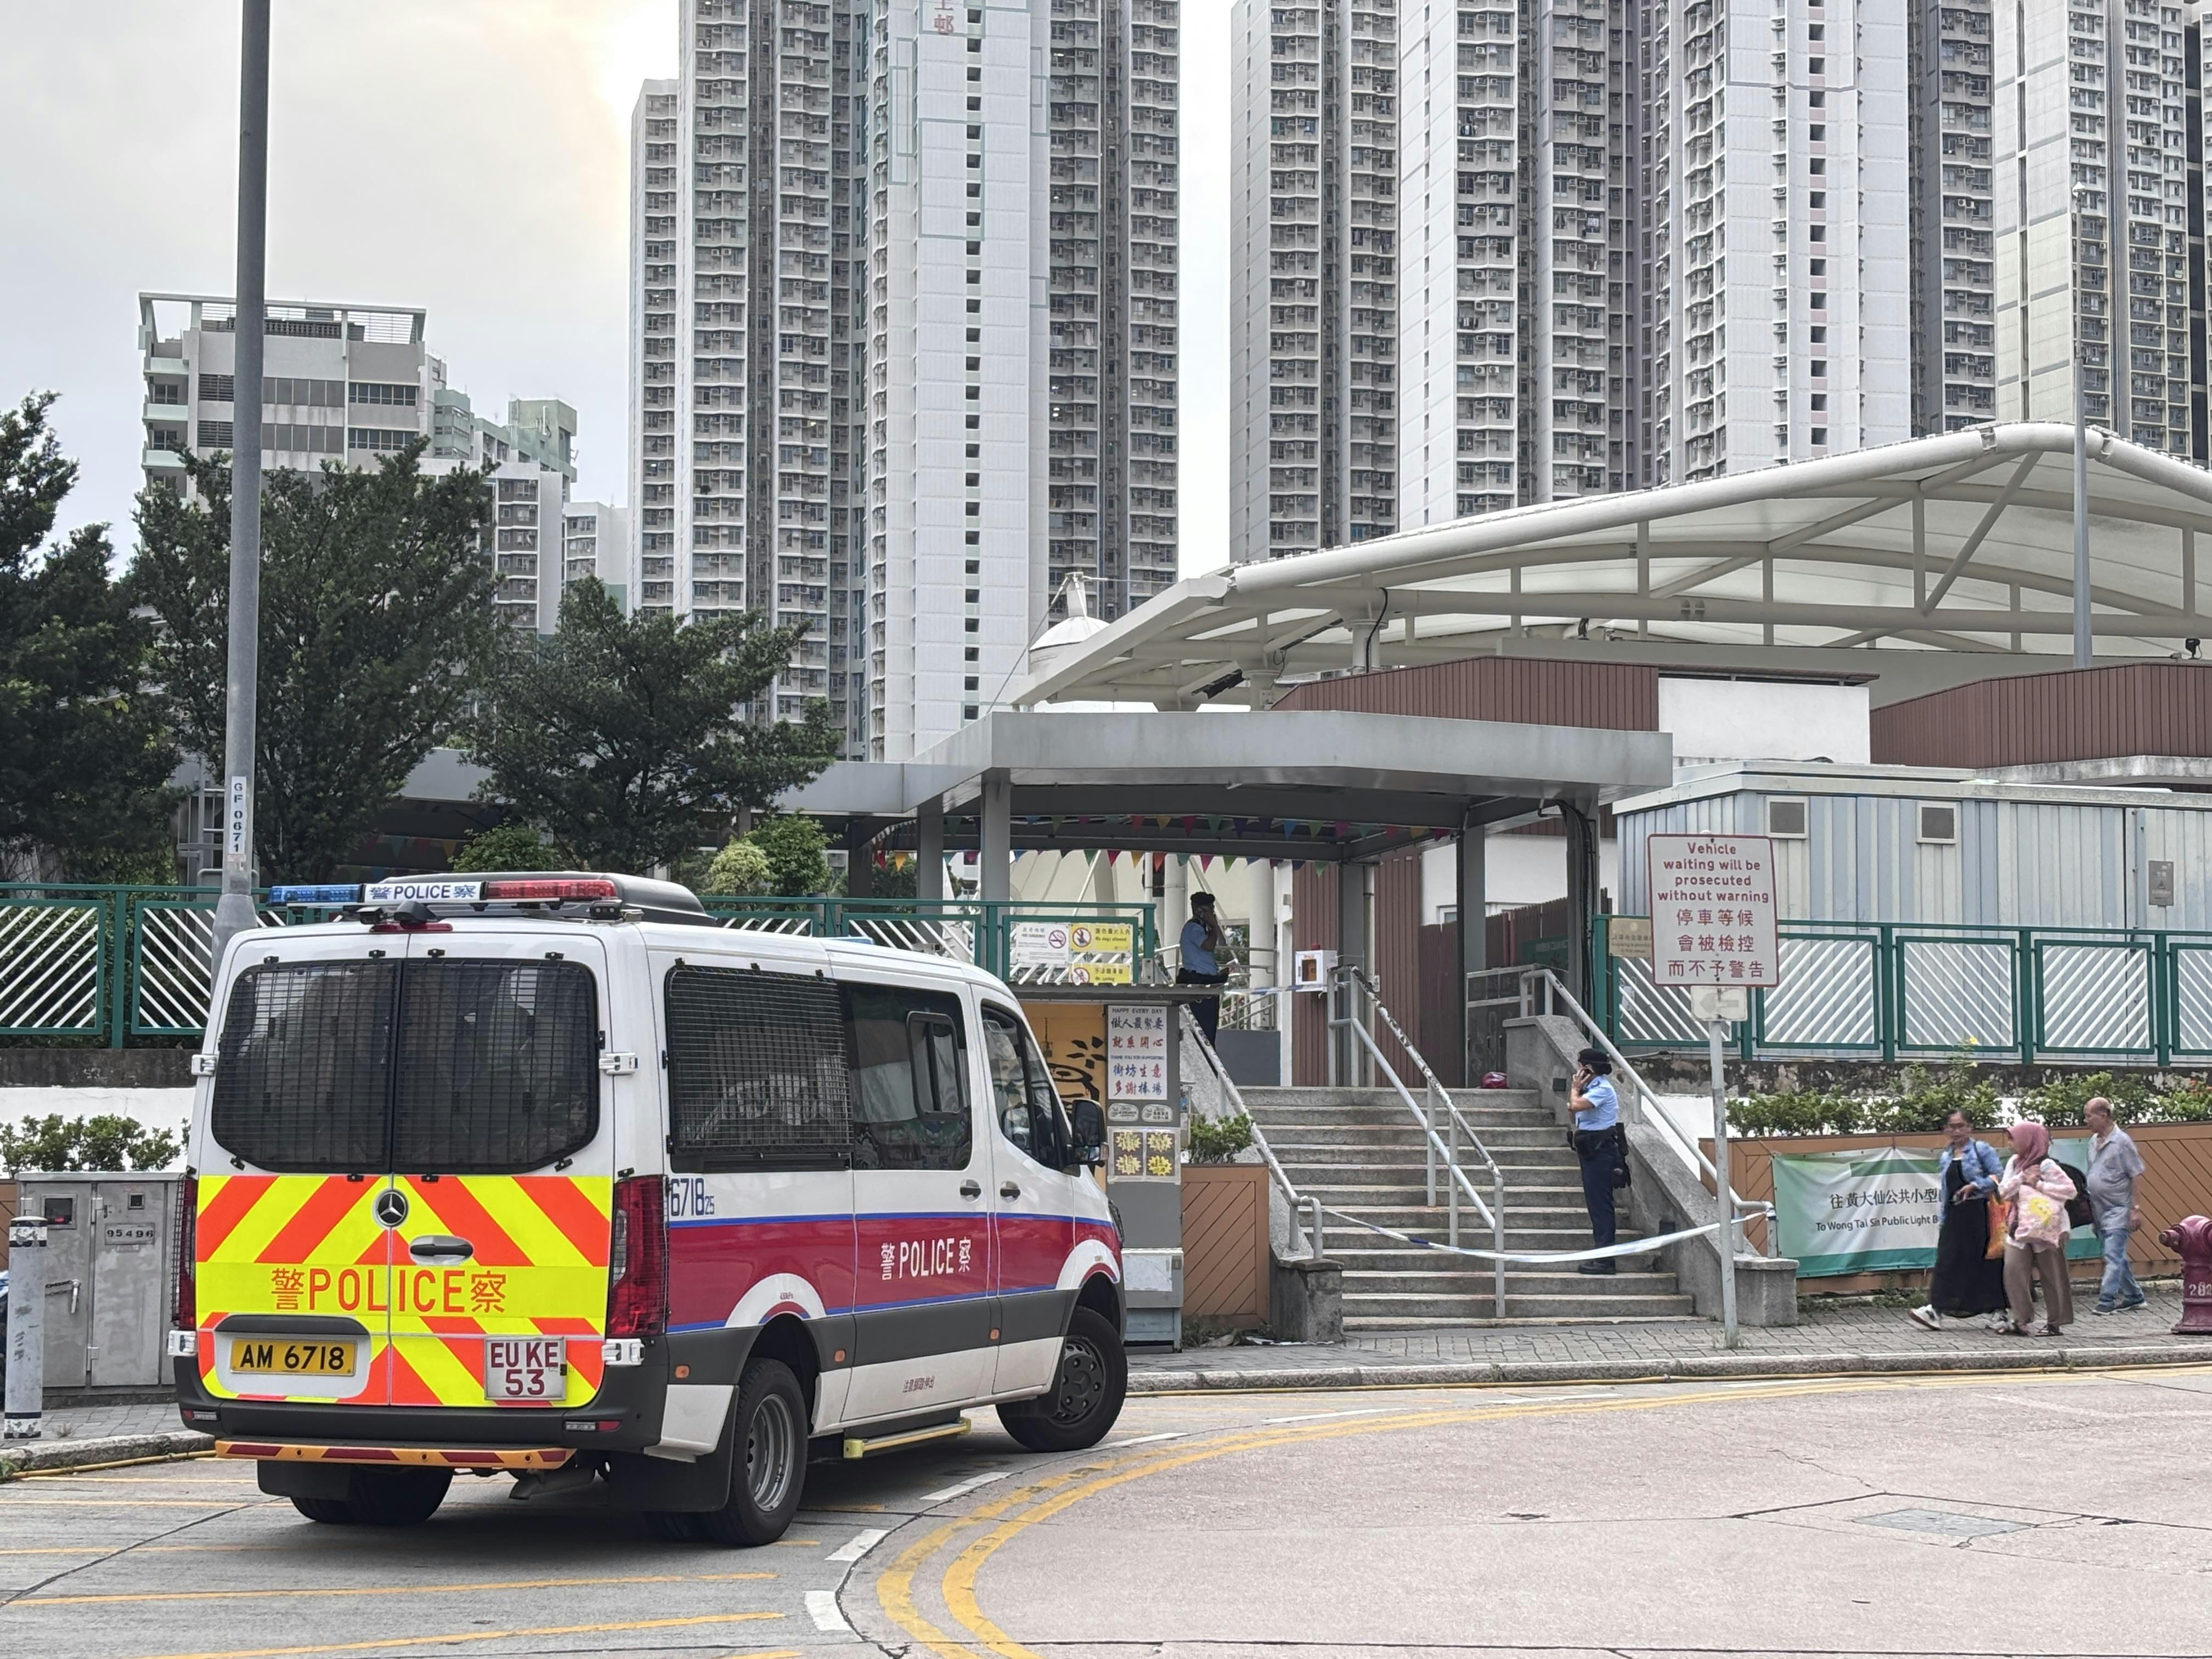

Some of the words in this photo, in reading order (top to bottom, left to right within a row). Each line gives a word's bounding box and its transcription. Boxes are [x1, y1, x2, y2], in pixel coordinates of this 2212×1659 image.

[233, 810, 242, 853] 0671
[1687, 842, 1736, 855] Vehicle
[1663, 859, 1714, 871] waiting
[1719, 859, 1742, 870] will
[1746, 860, 1760, 871] be
[1675, 875, 1751, 887] prosecuted
[393, 885, 451, 900] POLICE
[1657, 890, 1712, 901] without
[1716, 891, 1769, 903] warning
[1677, 909, 1753, 927] 停車等候
[1678, 934, 1755, 952] 會被檢控
[1667, 960, 1765, 978] 而不予警告
[1111, 1016, 1164, 1030] 做人最緊要
[1114, 1080, 1162, 1096] 多謝捧場
[671, 1178, 704, 1217] 6718
[1829, 1188, 1943, 1209] 往黃大仙公共小型
[1816, 1222, 1826, 1232] To
[1827, 1221, 1854, 1232] Wong
[1854, 1219, 1868, 1228] Tai
[1870, 1217, 1880, 1227] Sin
[1882, 1216, 1910, 1226] Public
[1910, 1215, 1931, 1227] Light
[1932, 1215, 1938, 1224] B
[106, 1229, 154, 1238] 95496
[899, 1237, 955, 1279] POLICE
[309, 1268, 466, 1313] POLICE
[240, 1344, 273, 1368] AM
[284, 1345, 345, 1370] 6718
[490, 1342, 519, 1368] EU
[526, 1342, 558, 1368] KE
[505, 1368, 545, 1396] 53
